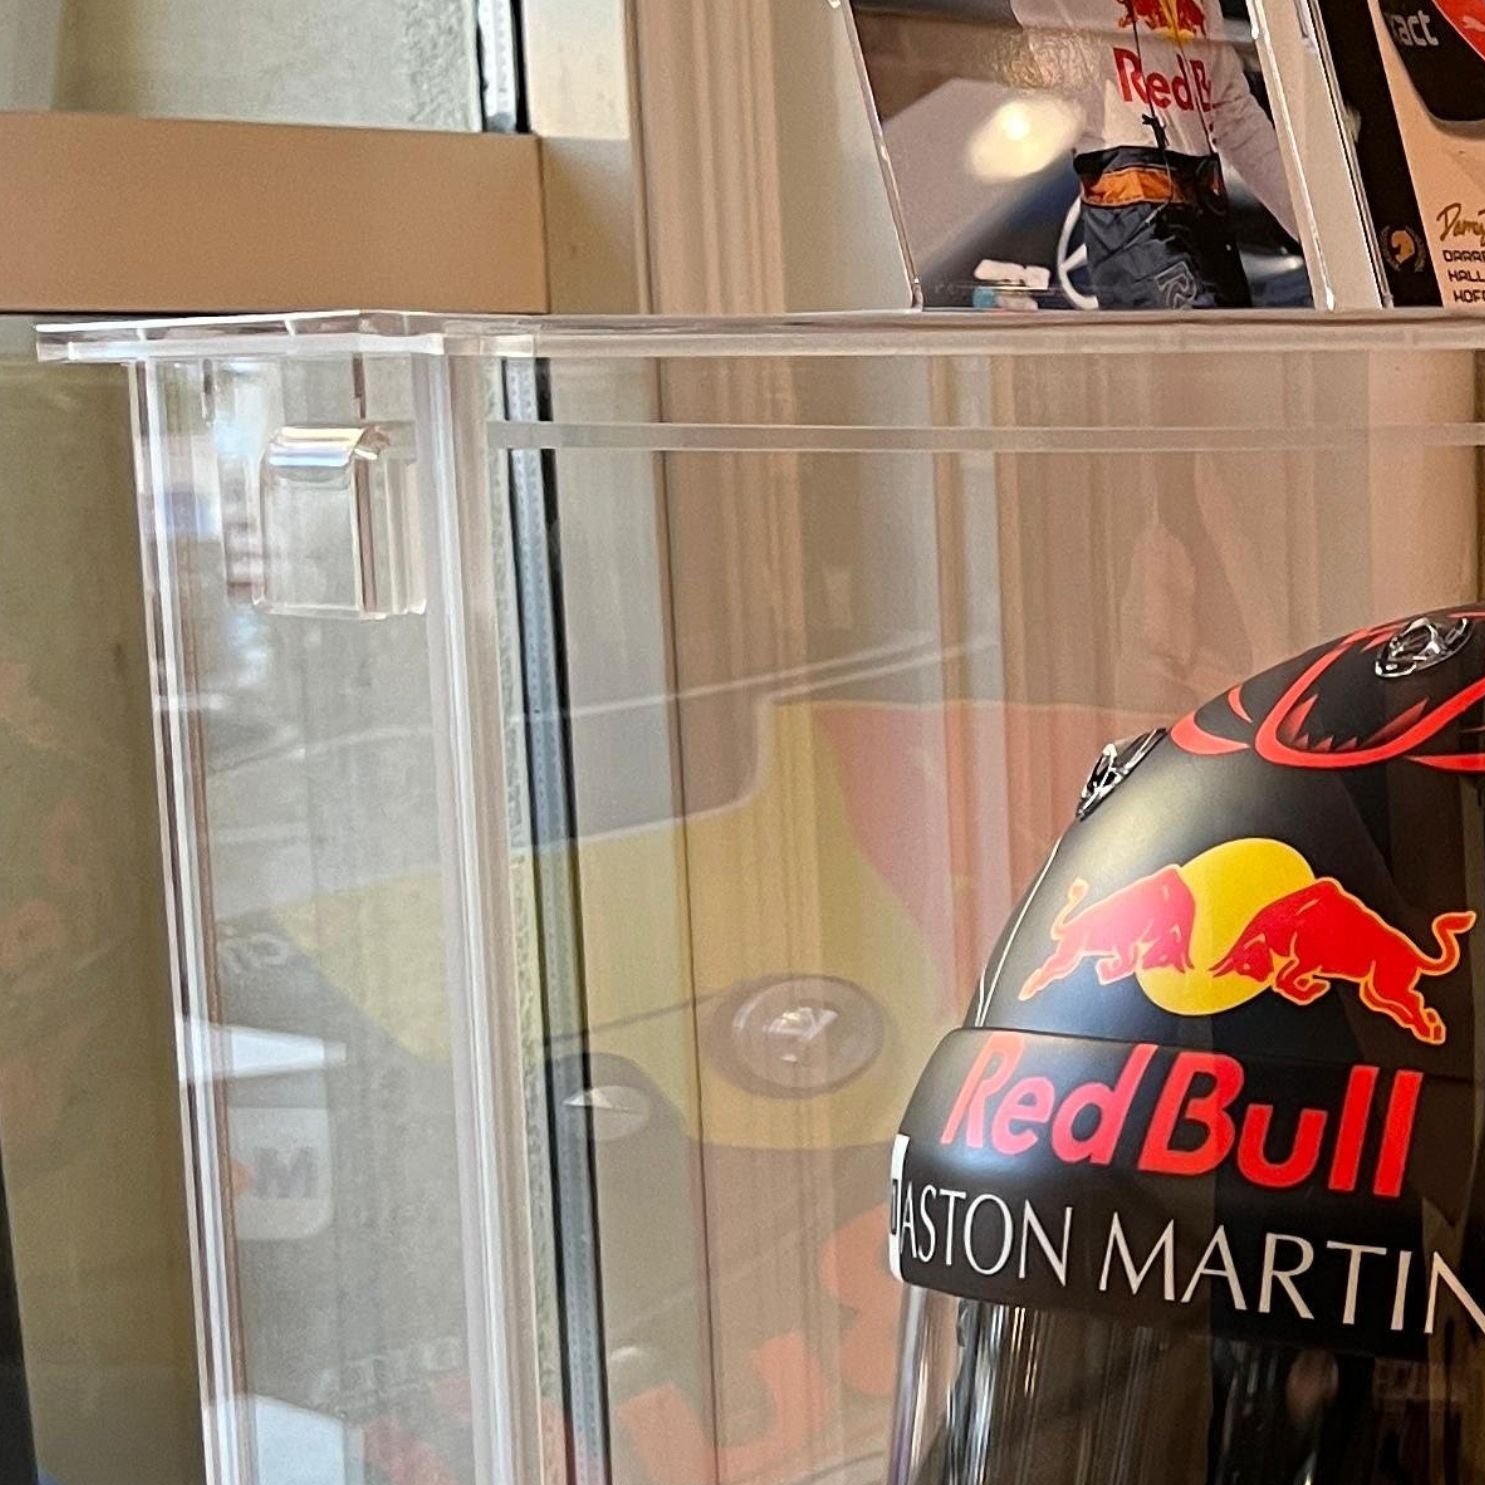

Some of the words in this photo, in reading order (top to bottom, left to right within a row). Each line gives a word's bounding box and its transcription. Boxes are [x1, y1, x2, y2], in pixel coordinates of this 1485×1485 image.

[940, 1032, 1157, 1166] Red
[1137, 1051, 1423, 1198] Bull
[900, 1181, 1072, 1287] ASTON
